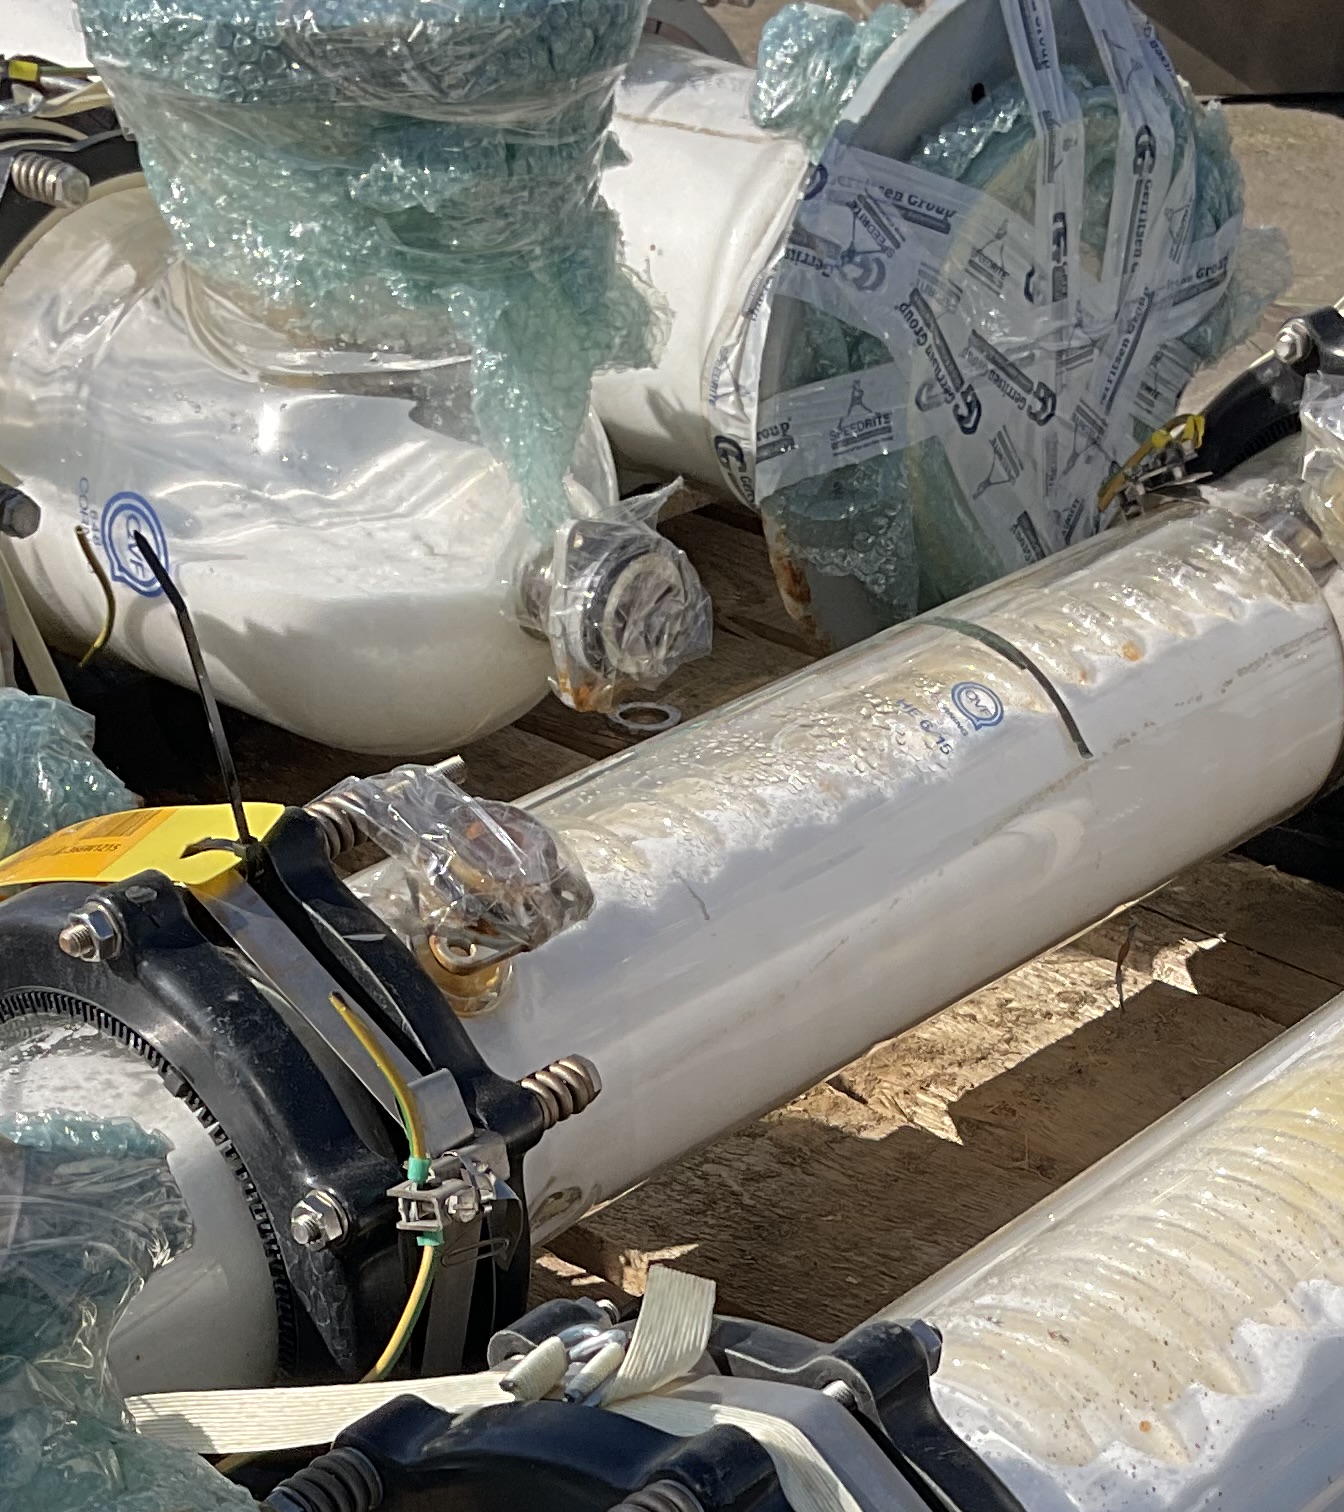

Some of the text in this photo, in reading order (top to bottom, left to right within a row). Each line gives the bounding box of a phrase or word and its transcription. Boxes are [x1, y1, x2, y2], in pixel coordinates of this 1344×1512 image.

[898, 302, 928, 347] Group
[829, 413, 893, 442] SPEEDRITE
[964, 689, 993, 717] QVF
